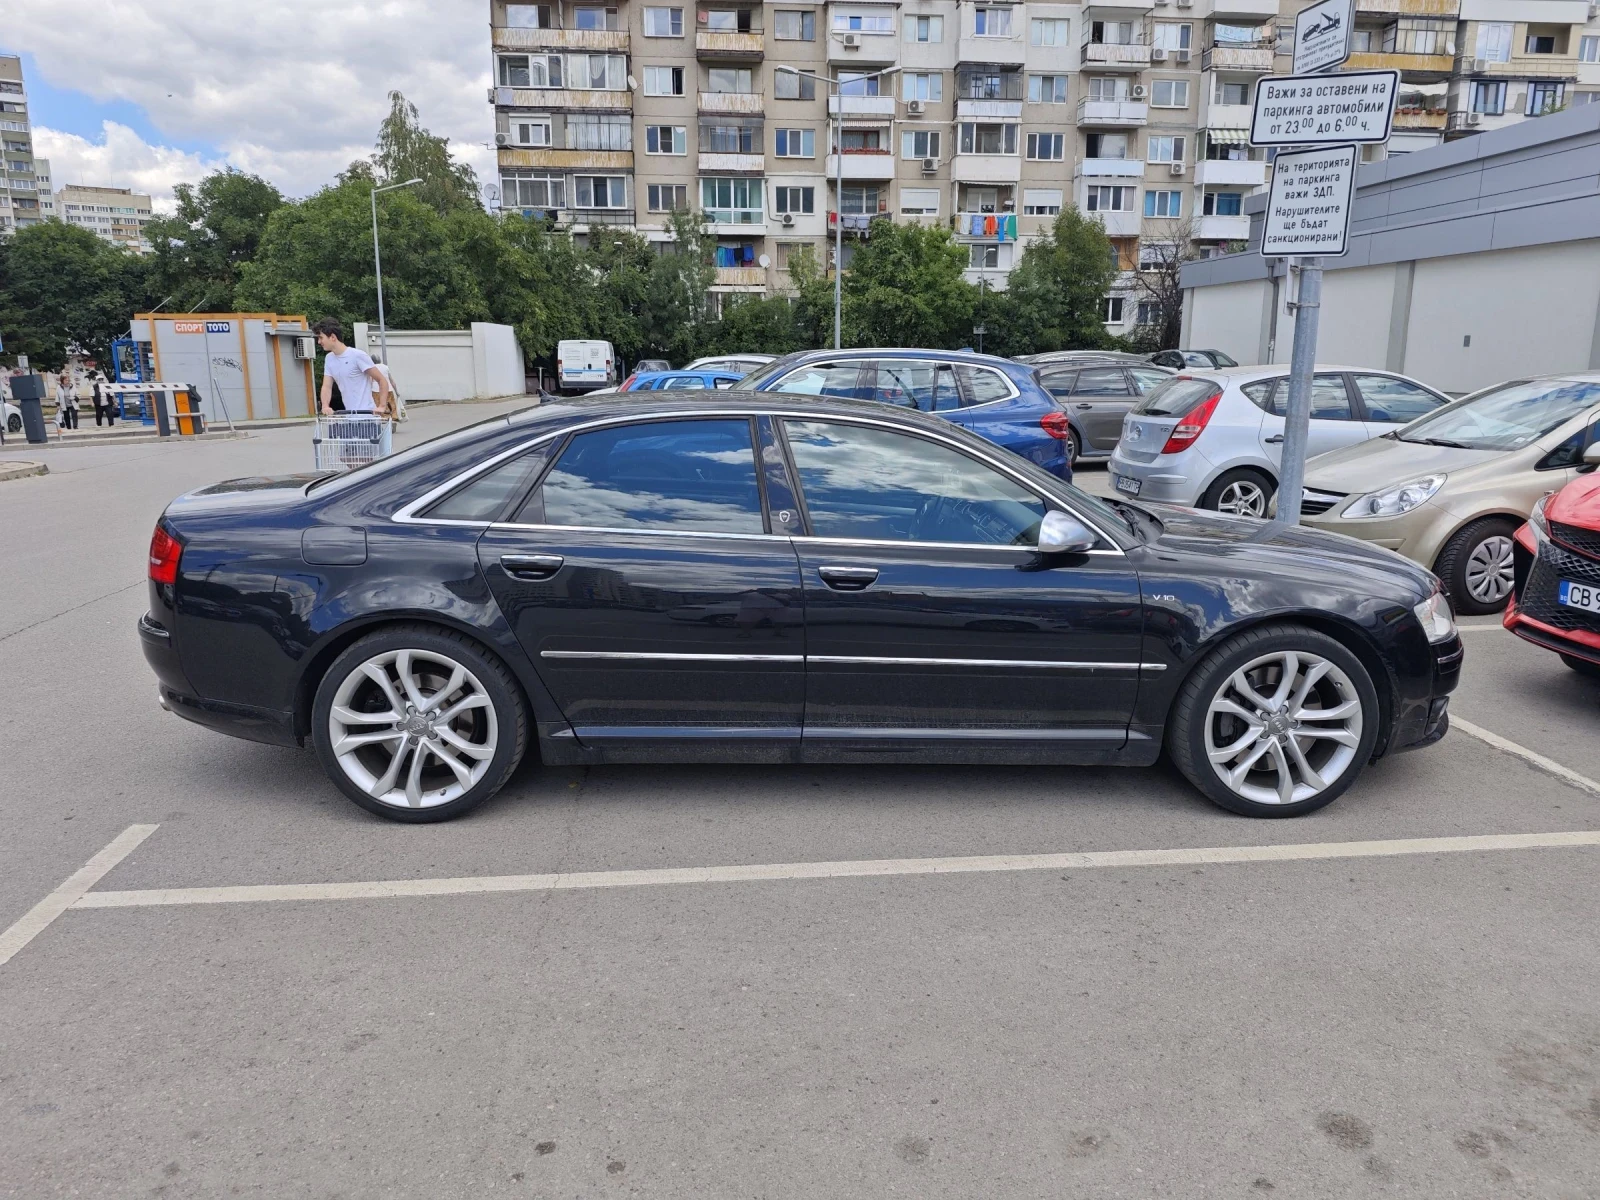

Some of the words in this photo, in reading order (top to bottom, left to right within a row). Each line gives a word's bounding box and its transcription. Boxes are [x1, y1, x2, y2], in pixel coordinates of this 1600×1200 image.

[1267, 86, 1296, 99] Важи
[1300, 87, 1312, 97] за
[1316, 84, 1368, 96] оставени
[1372, 83, 1386, 93] на
[1264, 106, 1313, 119] паркинга
[1317, 100, 1384, 114] автомобили
[1271, 125, 1281, 134] от
[1316, 123, 1330, 134] до
[1361, 121, 1370, 131] ч.
[1278, 164, 1288, 173] На
[1294, 159, 1349, 173] територията
[1284, 178, 1293, 186] на
[1298, 174, 1340, 187] паркинга
[1285, 191, 1308, 199] важи
[1313, 186, 1334, 198] ЗДП.
[1276, 206, 1340, 218] Нарушителите
[1284, 222, 1296, 230] ще
[1301, 219, 1328, 229] бъдат
[1267, 232, 1342, 244] санкционирани!
[175, 323, 203, 332] СПОРТ
[207, 323, 229, 332] ТОТО
